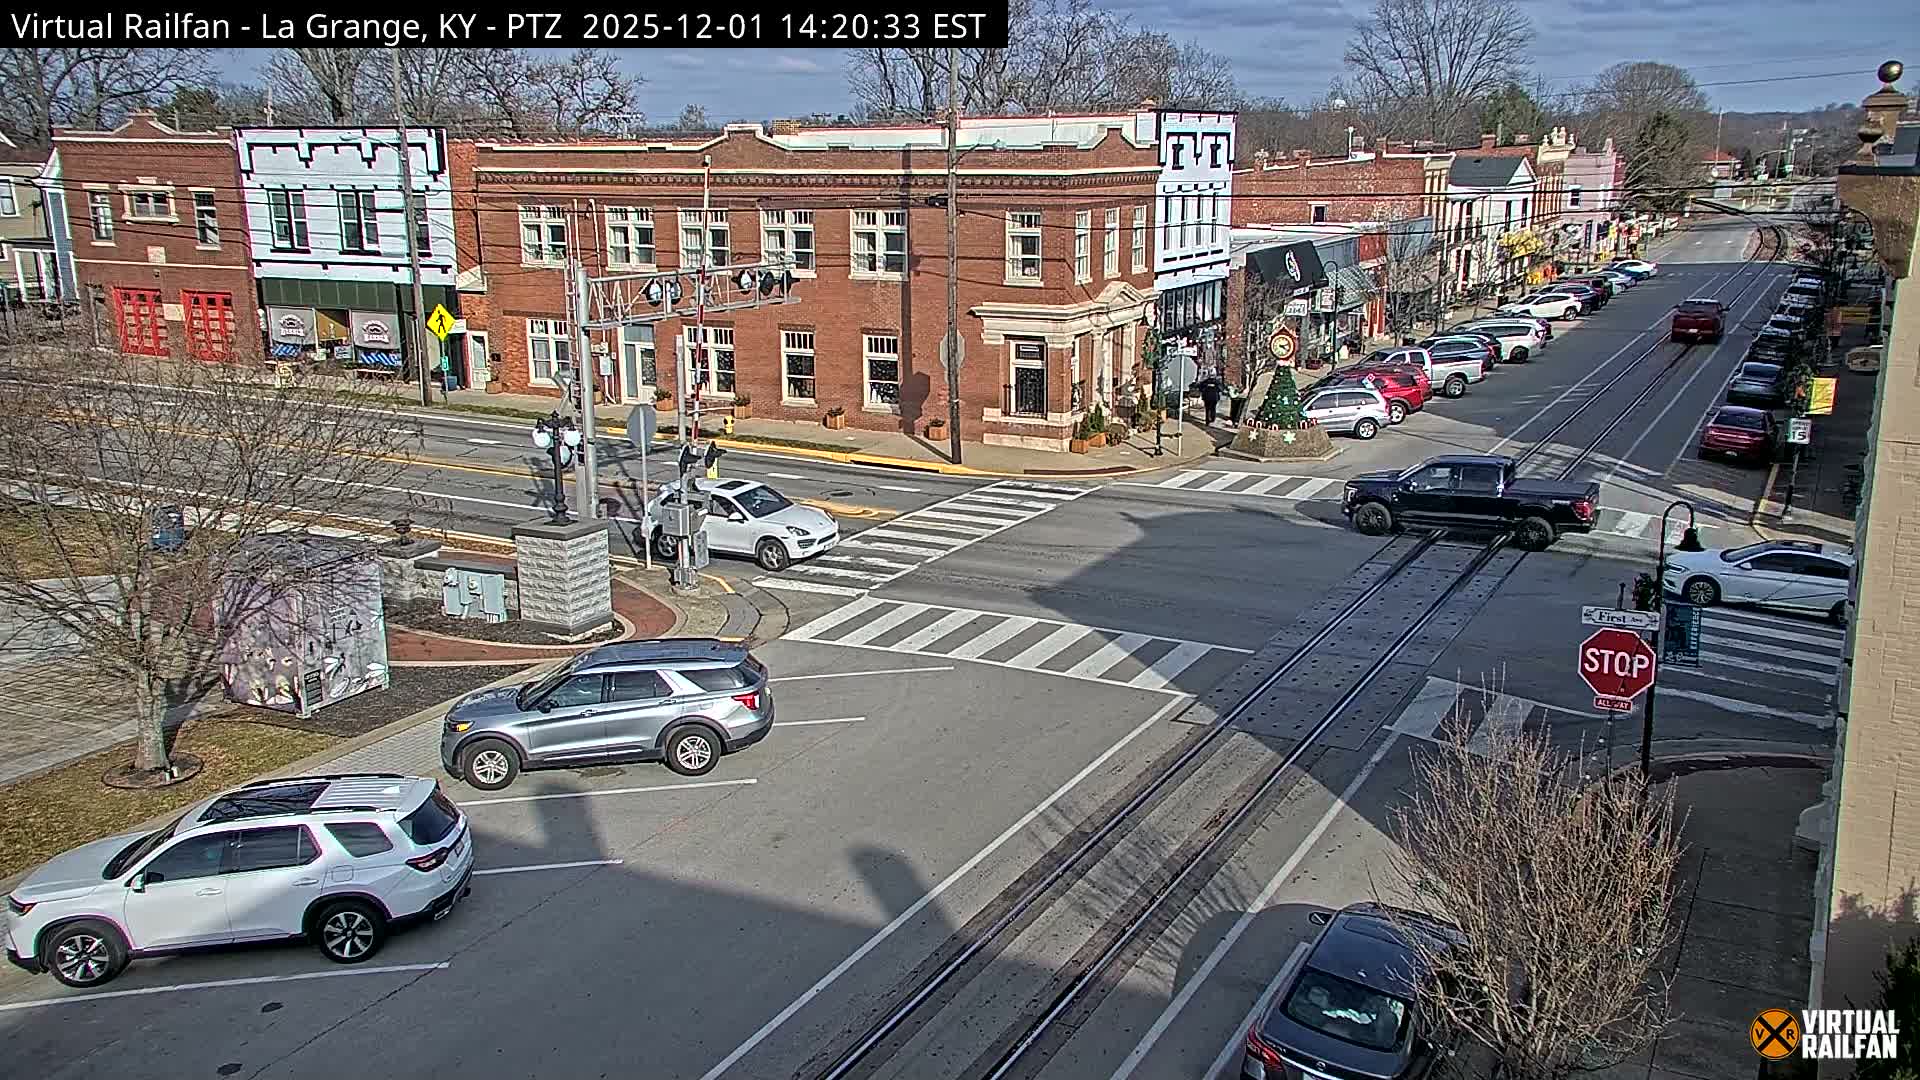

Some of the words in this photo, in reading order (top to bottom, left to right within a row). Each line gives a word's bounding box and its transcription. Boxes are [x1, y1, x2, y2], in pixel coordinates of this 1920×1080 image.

[1792, 431, 1806, 440] 15
[1599, 611, 1626, 623] First
[1584, 647, 1650, 678] STOP
[1597, 698, 1611, 707] ALL
